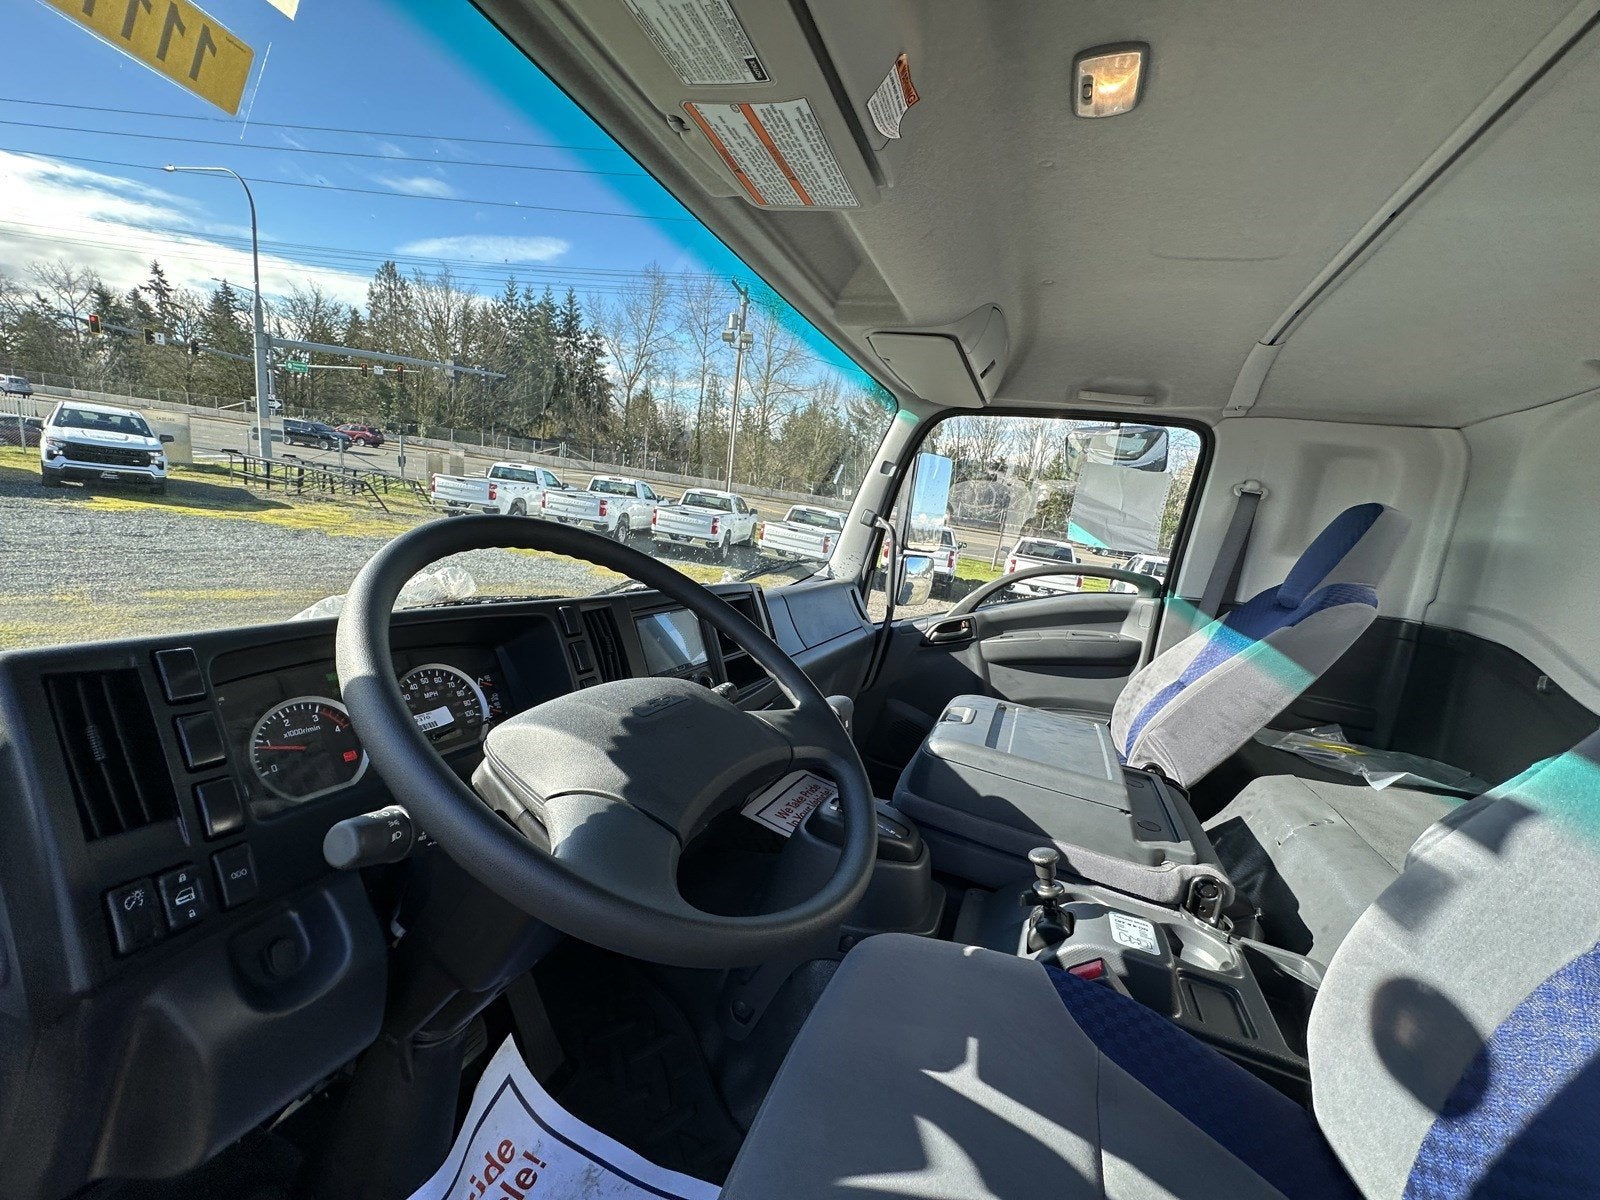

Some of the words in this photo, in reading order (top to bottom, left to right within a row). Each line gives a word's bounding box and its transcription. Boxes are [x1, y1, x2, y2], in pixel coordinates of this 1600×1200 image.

[747, 60, 763, 79] NOTICE
[410, 683, 418, 691] 40
[312, 714, 319, 722] 3
[283, 719, 291, 727] 2
[334, 725, 341, 733] 4
[270, 764, 278, 773] 0
[775, 807, 794, 820] We
[786, 796, 807, 811] Take
[800, 784, 821, 797] Pride
[793, 807, 810, 821] Your
[499, 1150, 547, 1200] le!
